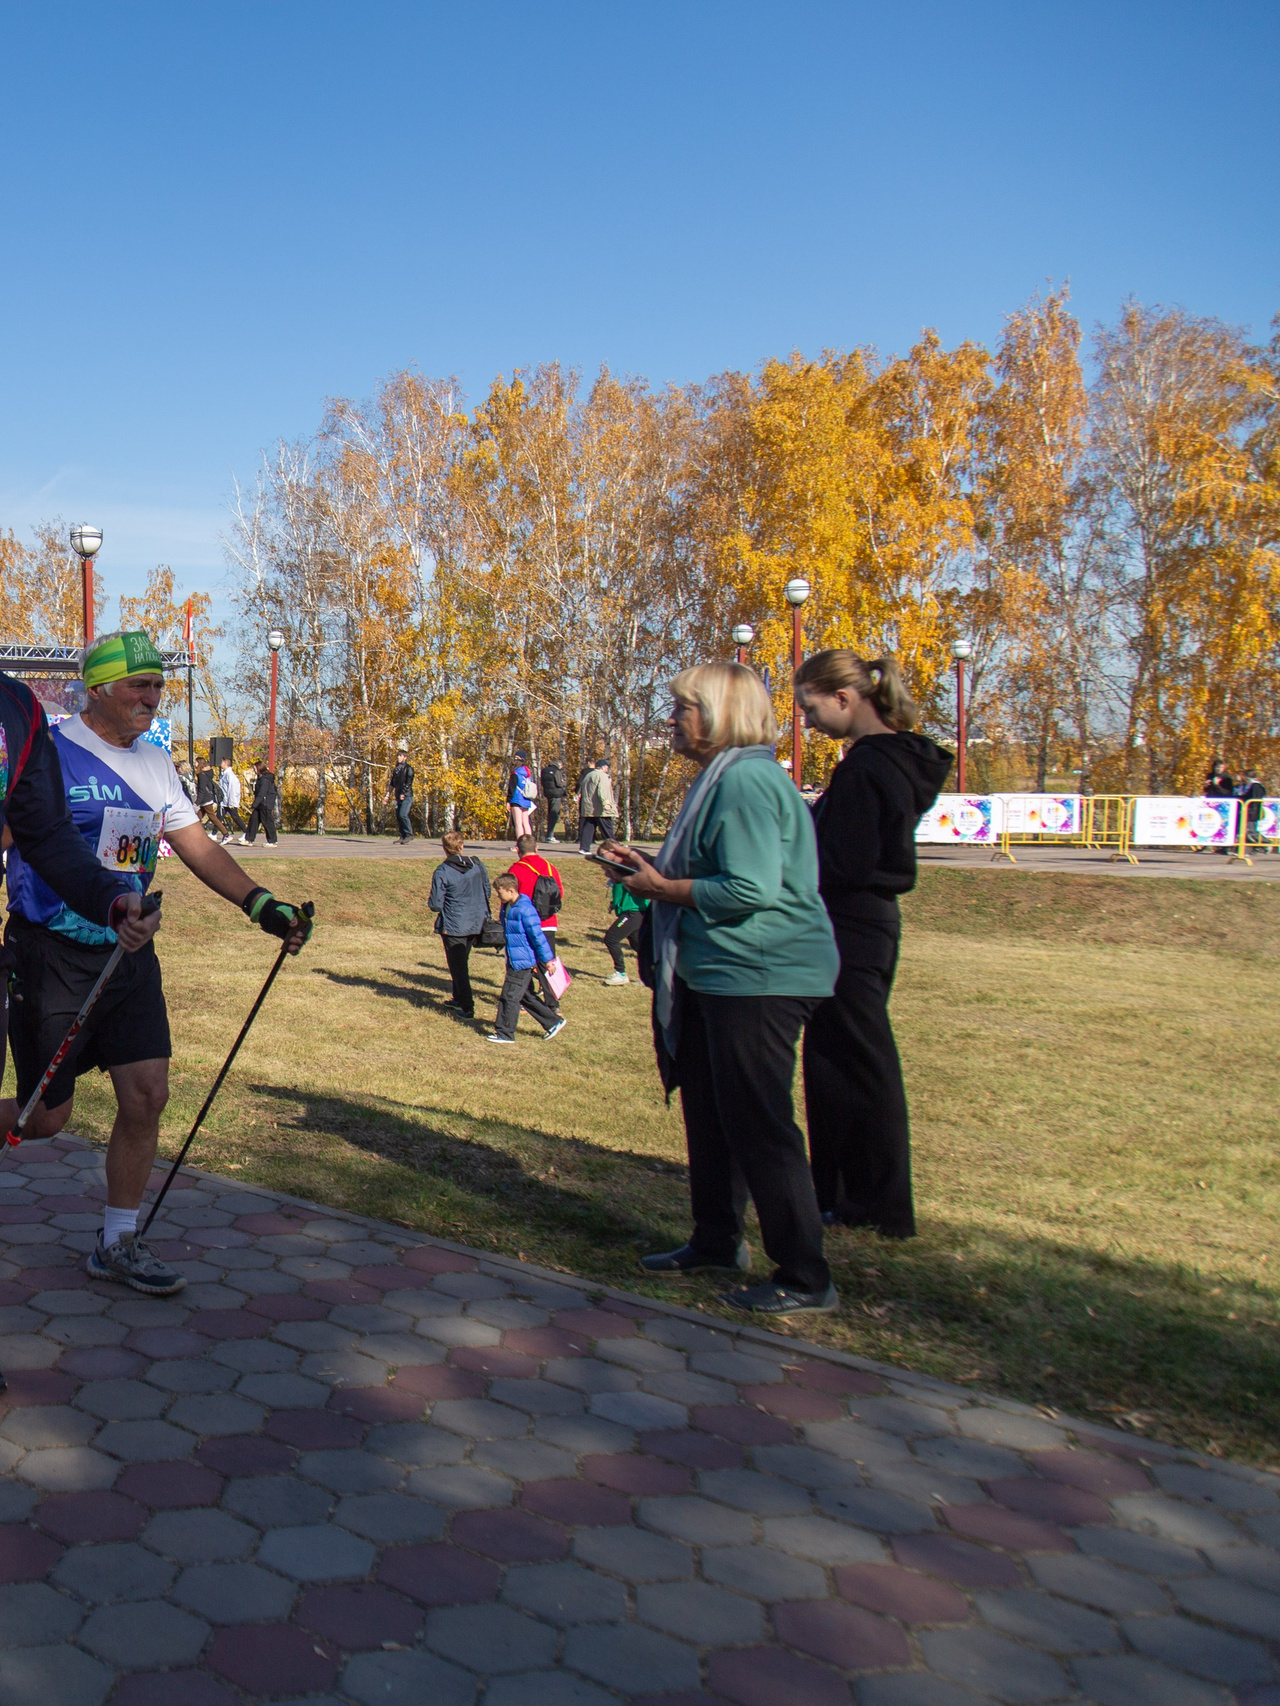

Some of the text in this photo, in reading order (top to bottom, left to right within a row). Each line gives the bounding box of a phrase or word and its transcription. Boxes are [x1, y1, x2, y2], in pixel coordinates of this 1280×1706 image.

[130, 636, 154, 653] ЗАР
[134, 652, 145, 664] НА
[116, 834, 151, 865] 830
